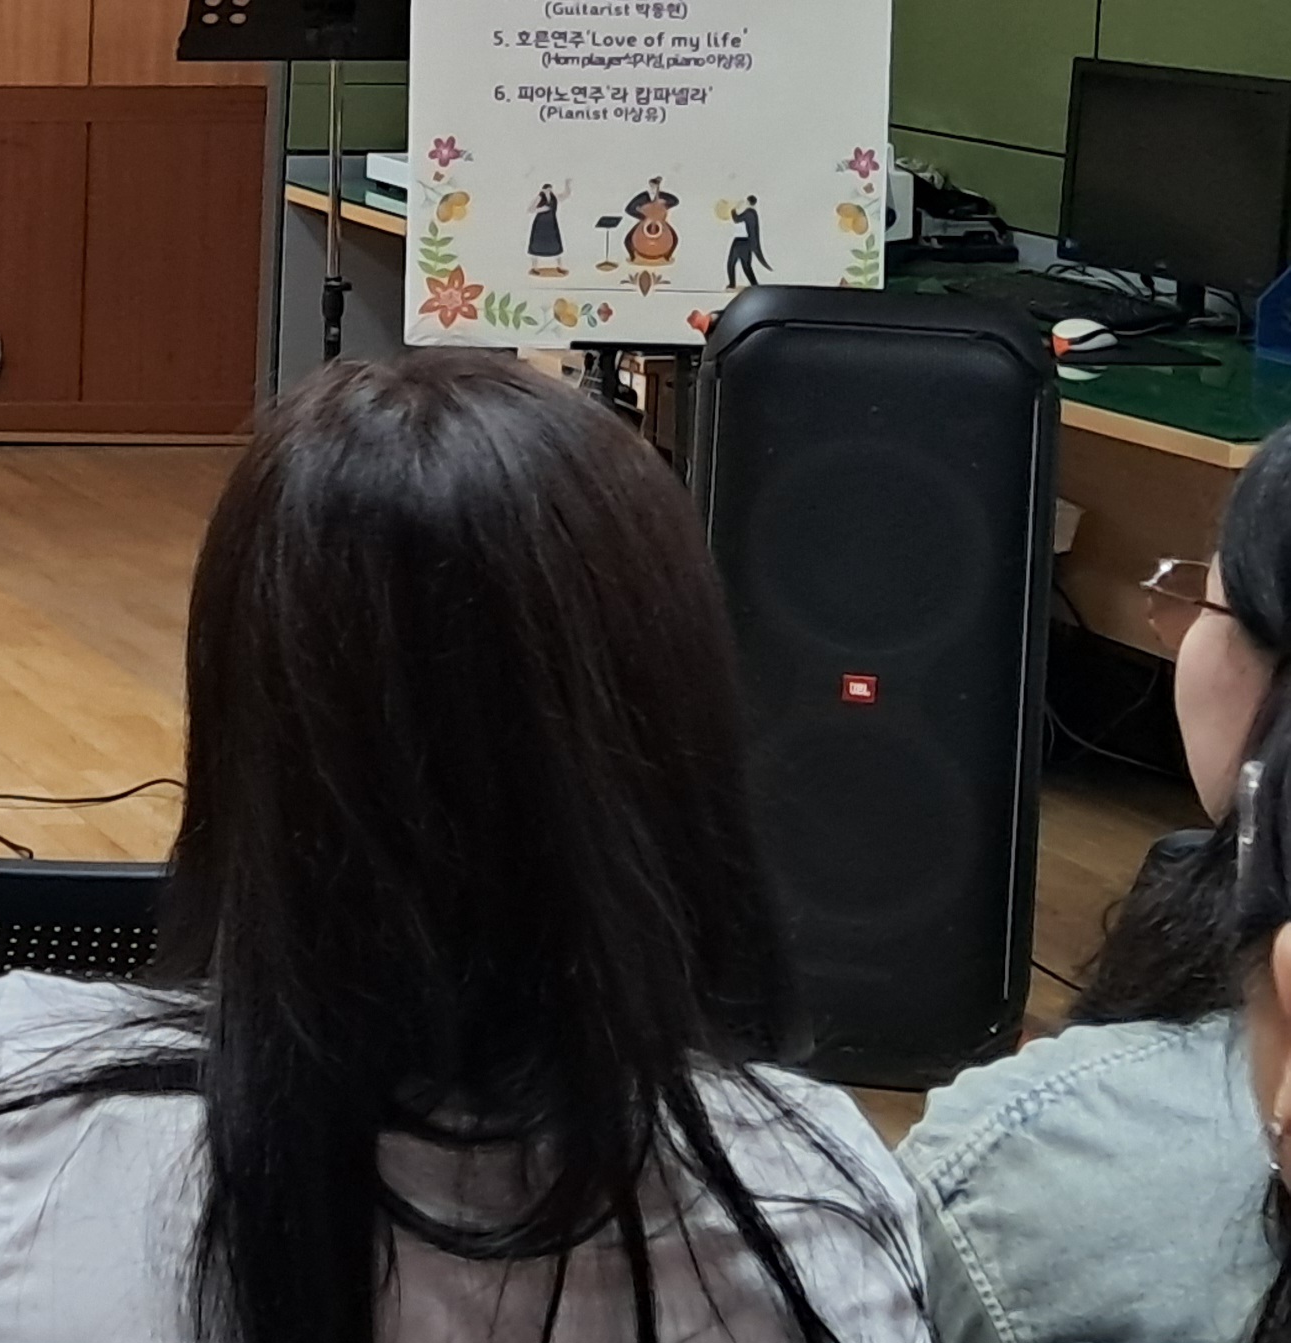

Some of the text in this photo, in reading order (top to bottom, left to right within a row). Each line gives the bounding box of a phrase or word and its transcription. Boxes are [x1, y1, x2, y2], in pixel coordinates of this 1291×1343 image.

[545, 2, 630, 20] (Guitarist
[492, 30, 510, 48] 5.
[643, 31, 666, 48] of
[670, 34, 701, 52] my
[494, 85, 512, 103] 6.
[538, 105, 609, 124] (Pianist
